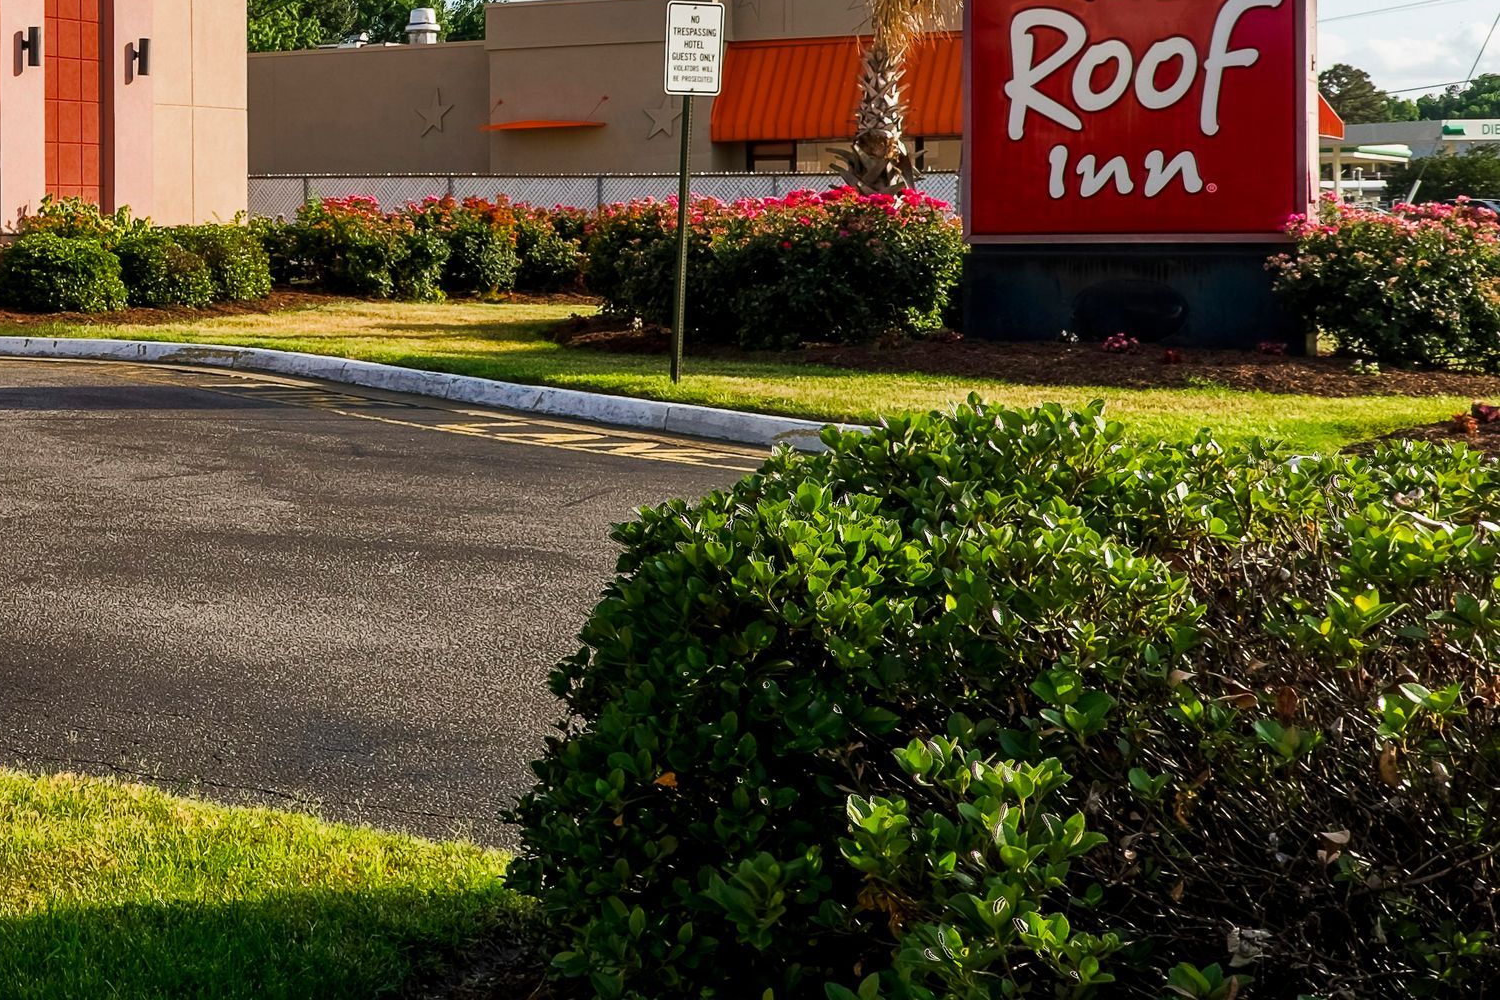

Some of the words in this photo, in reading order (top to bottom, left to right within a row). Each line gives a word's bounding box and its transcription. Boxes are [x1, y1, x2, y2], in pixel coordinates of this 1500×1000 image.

[691, 15, 700, 24] NO
[673, 27, 717, 37] TRESPASSING
[684, 40, 704, 49] HOTEL
[672, 52, 697, 61] GUESTS
[700, 54, 715, 62] ONLY
[1048, 144, 1203, 199] Inn
